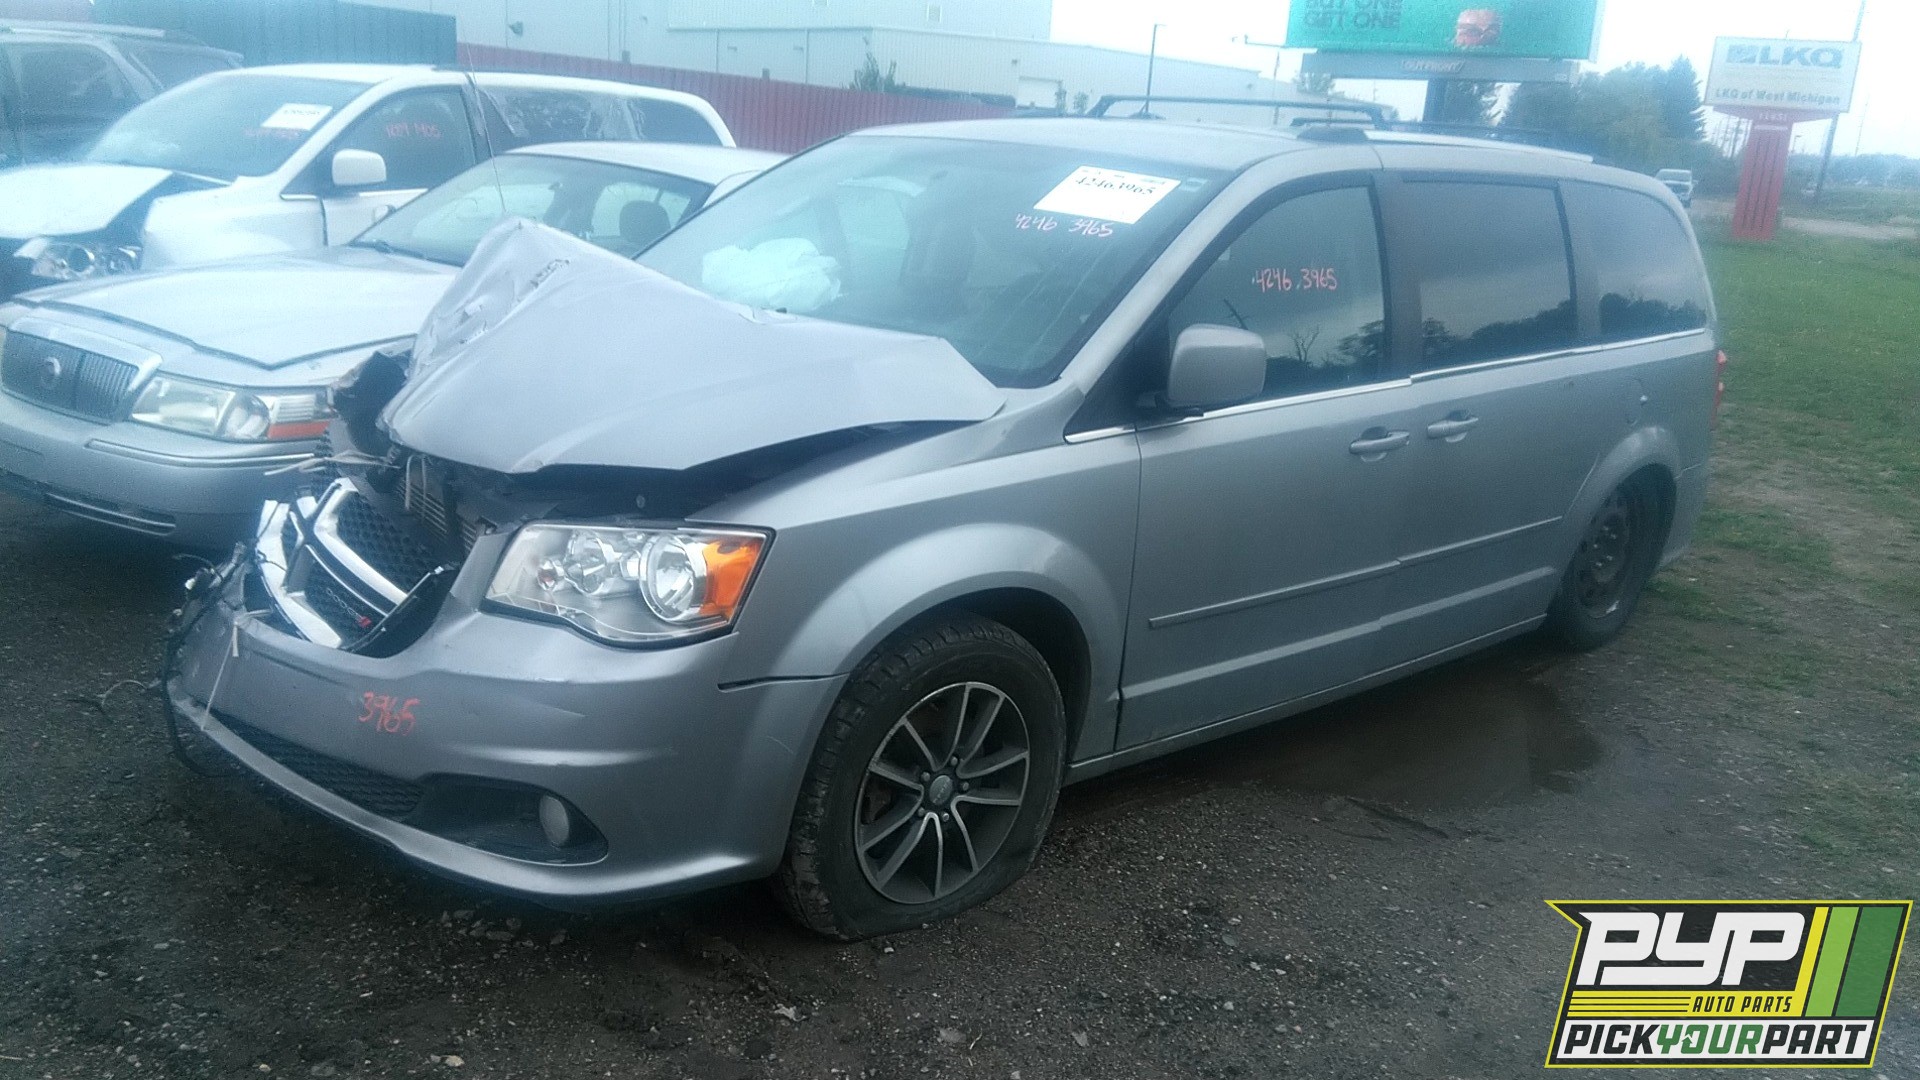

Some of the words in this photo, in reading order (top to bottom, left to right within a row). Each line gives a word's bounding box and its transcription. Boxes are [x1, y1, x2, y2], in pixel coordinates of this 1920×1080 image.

[1353, 11, 1401, 29] ONE
[1758, 46, 1843, 68] LKQ
[1716, 88, 1738, 99] LKQ
[1741, 89, 1753, 100] of
[1755, 90, 1784, 101] West
[1787, 91, 1840, 105] Michigan
[1014, 213, 1058, 231] 4246
[1068, 217, 1114, 237] 3965
[1255, 267, 1292, 293] 4246
[1301, 267, 1338, 290] 3965
[358, 691, 421, 736] 3965
